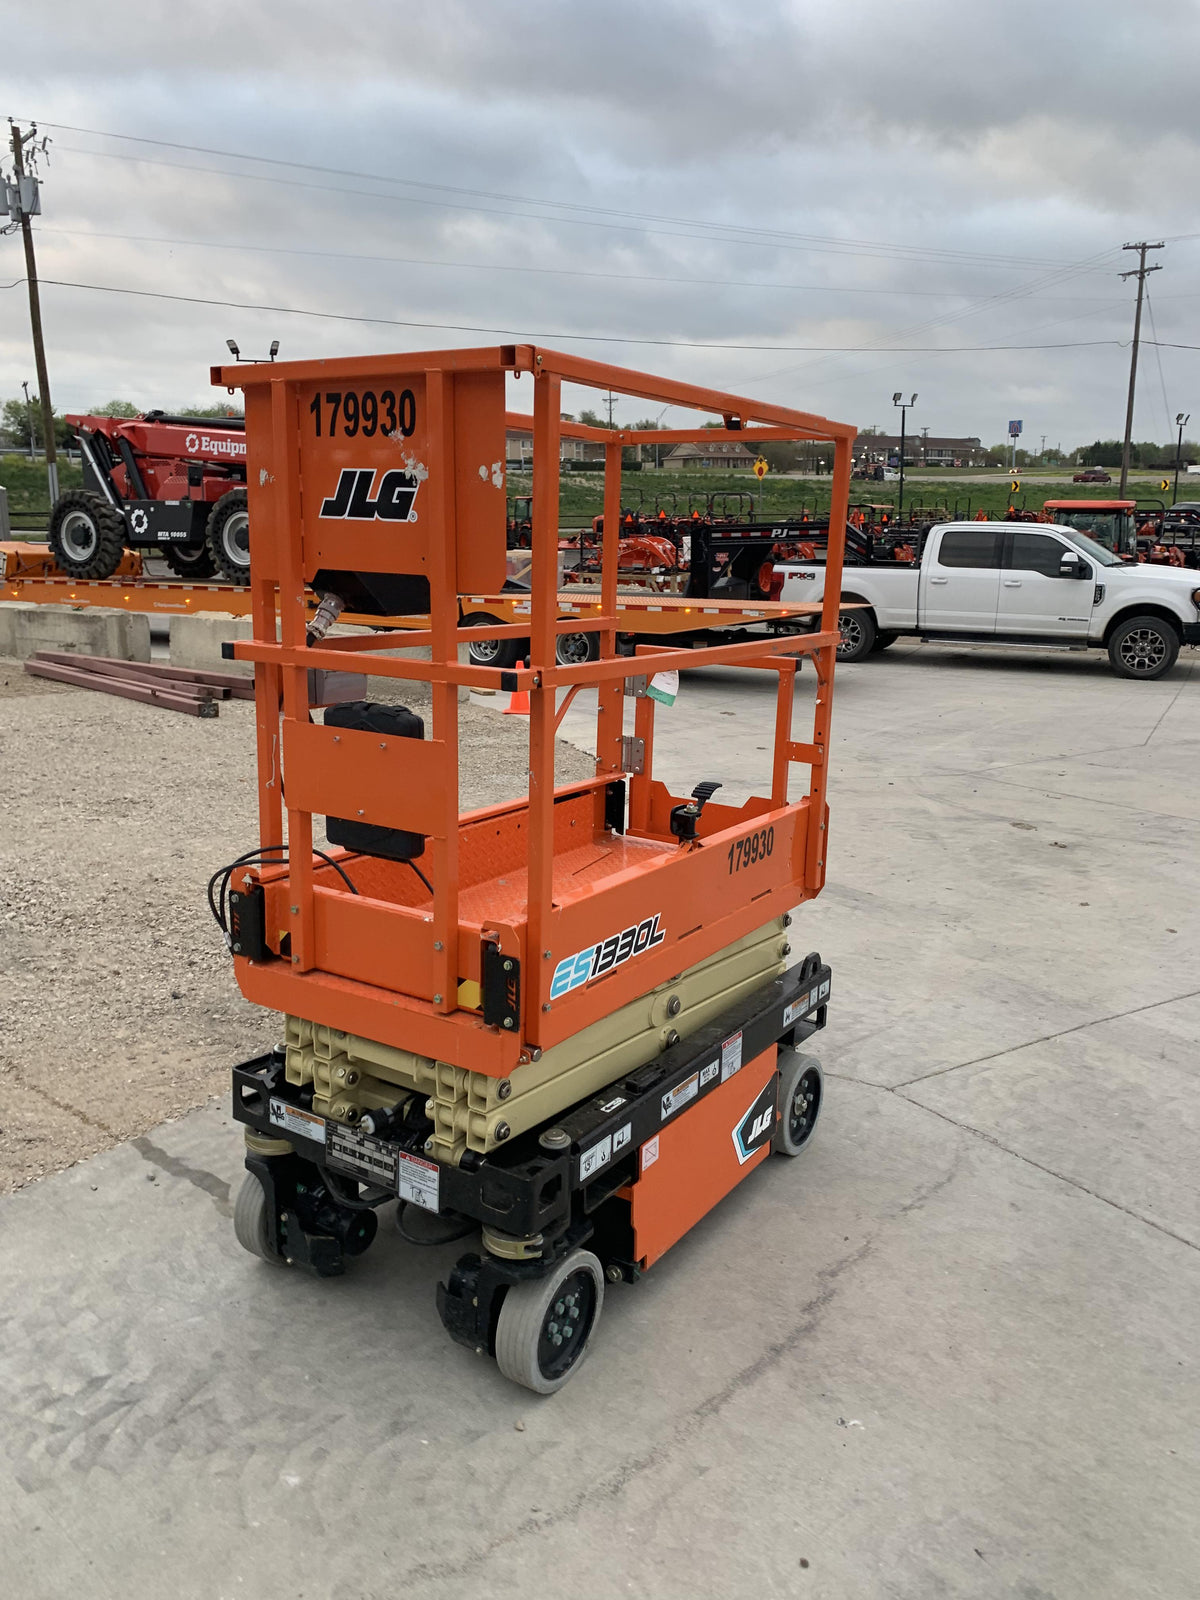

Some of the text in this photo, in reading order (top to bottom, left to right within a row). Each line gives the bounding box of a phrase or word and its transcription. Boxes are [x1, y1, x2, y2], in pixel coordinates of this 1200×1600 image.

[310, 389, 416, 437] 179930
[319, 468, 420, 522] JLG
[771, 529, 788, 538] PJ
[788, 572, 816, 580] FX4
[728, 826, 775, 875] 179930
[702, 1066, 711, 1077] MAX
[747, 1104, 774, 1145] JLG
